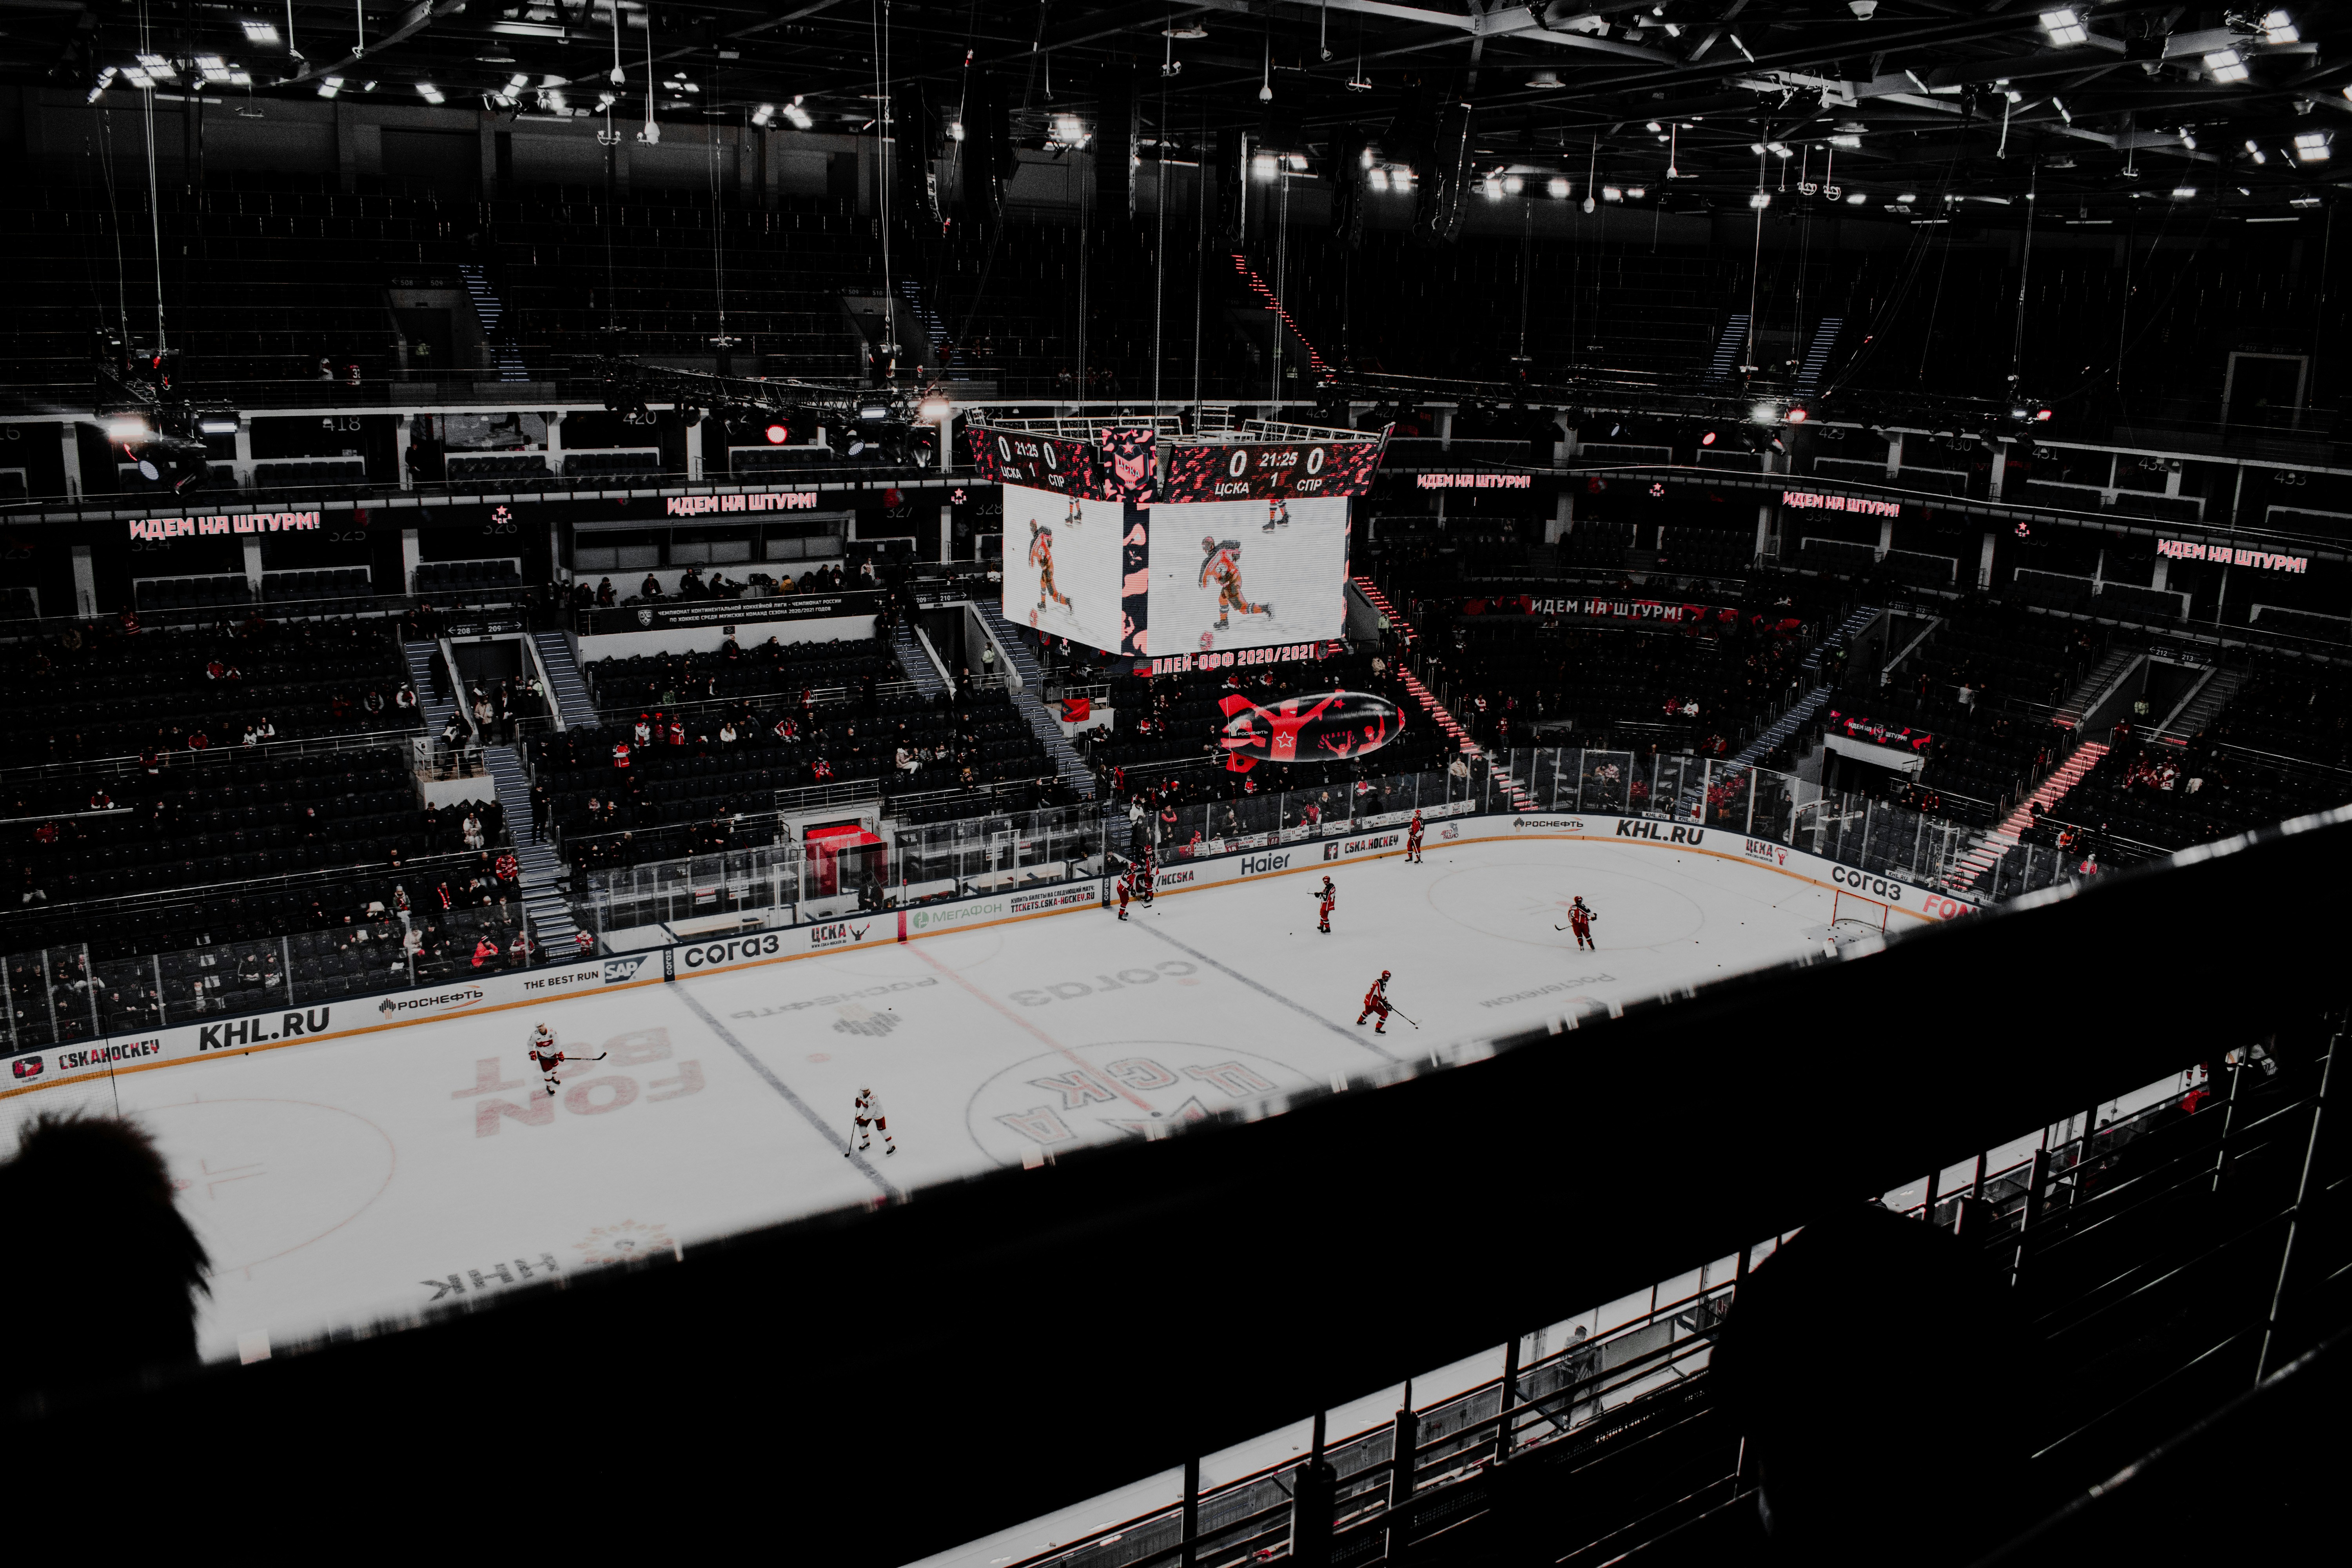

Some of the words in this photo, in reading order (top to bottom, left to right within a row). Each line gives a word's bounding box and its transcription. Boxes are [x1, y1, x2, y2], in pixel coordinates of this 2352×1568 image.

[323, 414, 361, 432] 418
[622, 411, 657, 425] 420
[985, 408, 1003, 420] 23
[1818, 427, 1846, 439] 429
[998, 436, 1011, 462] 0
[1014, 441, 1039, 458] 21:25
[1945, 438, 1972, 452] 430
[2032, 446, 2058, 460] 431
[1044, 442, 1056, 470] 0
[1229, 450, 1247, 477] 0
[1259, 451, 1298, 466] 21:25
[1307, 447, 1324, 474] 0
[1000, 466, 1022, 480] ЦСКА
[1029, 462, 1036, 477] 1
[1117, 459, 1140, 478] ЦСКА
[2274, 470, 2307, 486] 433
[1049, 474, 1065, 488] СПР
[1270, 472, 1278, 487] 1
[1297, 479, 1322, 491] СПР
[1417, 474, 1453, 489] ИДЕМ
[1455, 474, 1474, 488] НА
[1475, 474, 1530, 489] ШТУРМ!
[1215, 482, 1249, 497] ЦСКА
[667, 495, 719, 516] ИДЕМ
[722, 494, 744, 512] НА
[749, 492, 817, 511] ШТУРМ!
[1782, 491, 1823, 509] ИДЕМ
[1825, 495, 1845, 510] НА
[1846, 498, 1900, 517] ШТУРМ!
[129, 517, 195, 540] ИДЕМ
[199, 515, 230, 535] НА
[233, 511, 320, 533] ШТУРМ!
[492, 513, 512, 524] ЦСКА
[1806, 510, 1831, 523] 334
[2157, 539, 2207, 560] ИДЕМ
[2208, 545, 2233, 563] НА
[2234, 549, 2308, 573] ШТУРМ!
[691, 605, 742, 613] КОНТИНЕНТАЛЬНОЙ
[742, 602, 773, 610] ХОККЕЙНОЙ
[1531, 599, 1578, 614] ИДЕМ
[1584, 601, 1607, 614] НА
[1613, 603, 1682, 620] ШТУРМ!
[1152, 651, 1234, 675] ПЛЕЙ-ОФФ
[1237, 644, 1314, 666] 2020/2021
[1848, 722, 1864, 730] ИДЕМ
[1885, 731, 1908, 741] ШТУРМ!
[1616, 819, 1704, 845] KHL.RU
[1345, 834, 1398, 854] CSKA.HOCKEY
[1746, 838, 1773, 857] ЦСКА
[1241, 852, 1290, 876] Haier
[1156, 870, 1194, 887] /HCCSKA
[1887, 871, 1908, 881] KHL.RU
[1011, 892, 1095, 913] TICKETS.CSKA-HOCKEY.RU
[1029, 893, 1046, 902] БИЛЕТЫ
[1054, 887, 1079, 897] СЛЕДУЮЩИЙ
[1080, 885, 1095, 893] МАТЧ:
[811, 923, 847, 943] ЦСКА
[605, 961, 639, 980] SAP
[524, 979, 545, 990] THE
[548, 975, 574, 987] BEST
[577, 971, 599, 982] RUN
[397, 990, 484, 1011] РОСНЕФТЬ
[200, 1007, 330, 1051] KHL.RU
[59, 1039, 160, 1071] CSKAHOCKEY
[476, 1059, 705, 1138] FON
[994, 1057, 1278, 1146] ЦСКА
[419, 1252, 560, 1301] ННК
